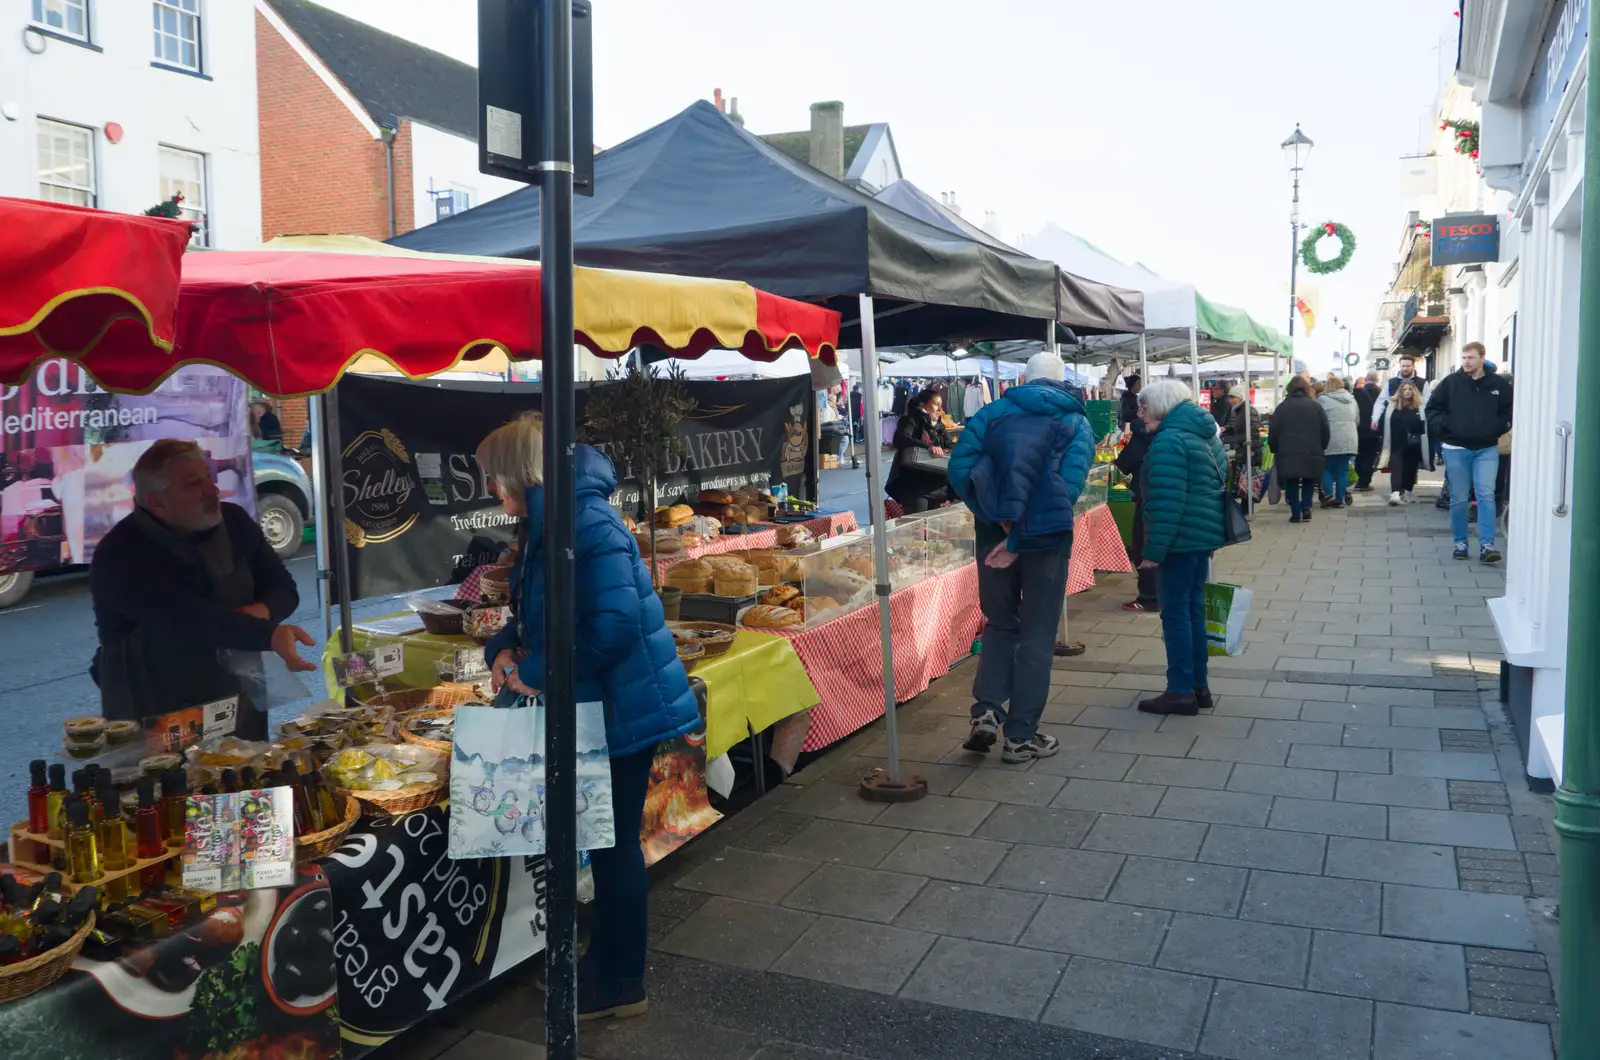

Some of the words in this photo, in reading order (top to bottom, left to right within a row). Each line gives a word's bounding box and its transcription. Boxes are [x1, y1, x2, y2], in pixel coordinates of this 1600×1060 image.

[1437, 223, 1492, 238] TESCO
[664, 427, 765, 474] BAKERY
[451, 553, 473, 568] Tel:
[325, 833, 462, 1011] taste
